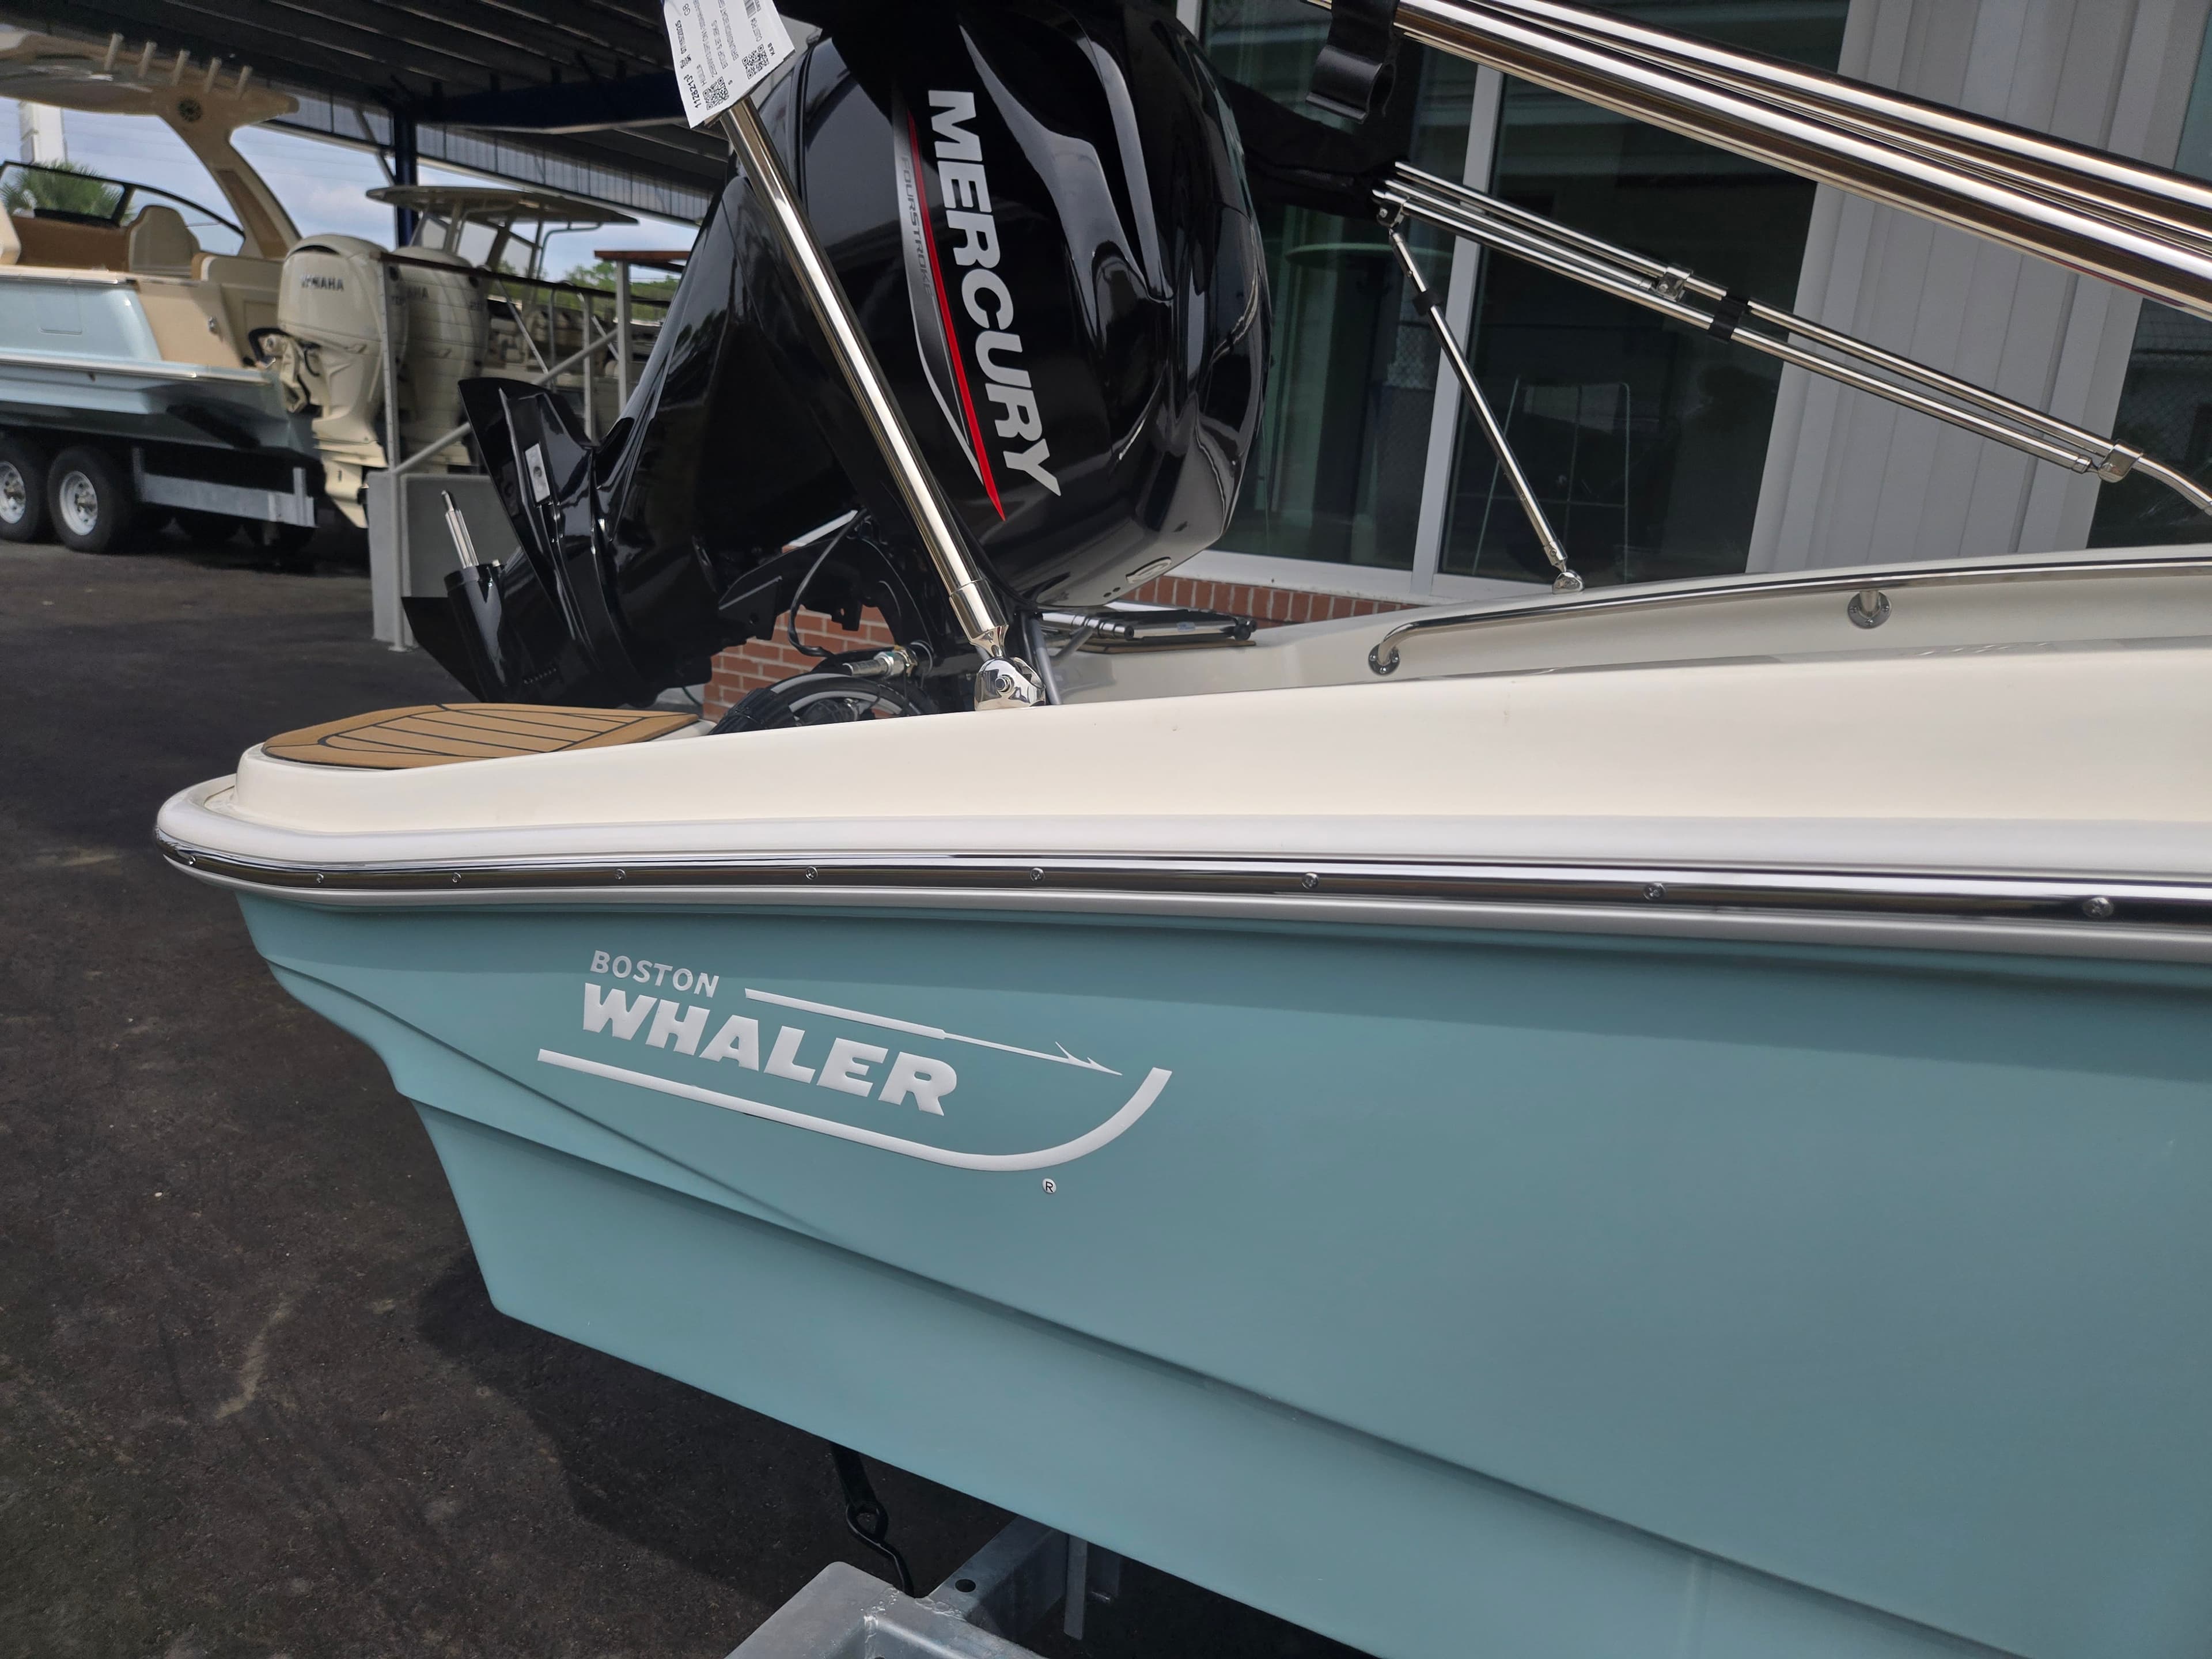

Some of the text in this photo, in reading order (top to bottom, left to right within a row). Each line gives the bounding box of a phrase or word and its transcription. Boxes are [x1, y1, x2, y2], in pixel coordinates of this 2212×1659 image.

[683, 3, 690, 16] GB
[928, 90, 1061, 497] MERCURY
[590, 949, 719, 998] BOSTON
[582, 982, 957, 1116] WHALER
